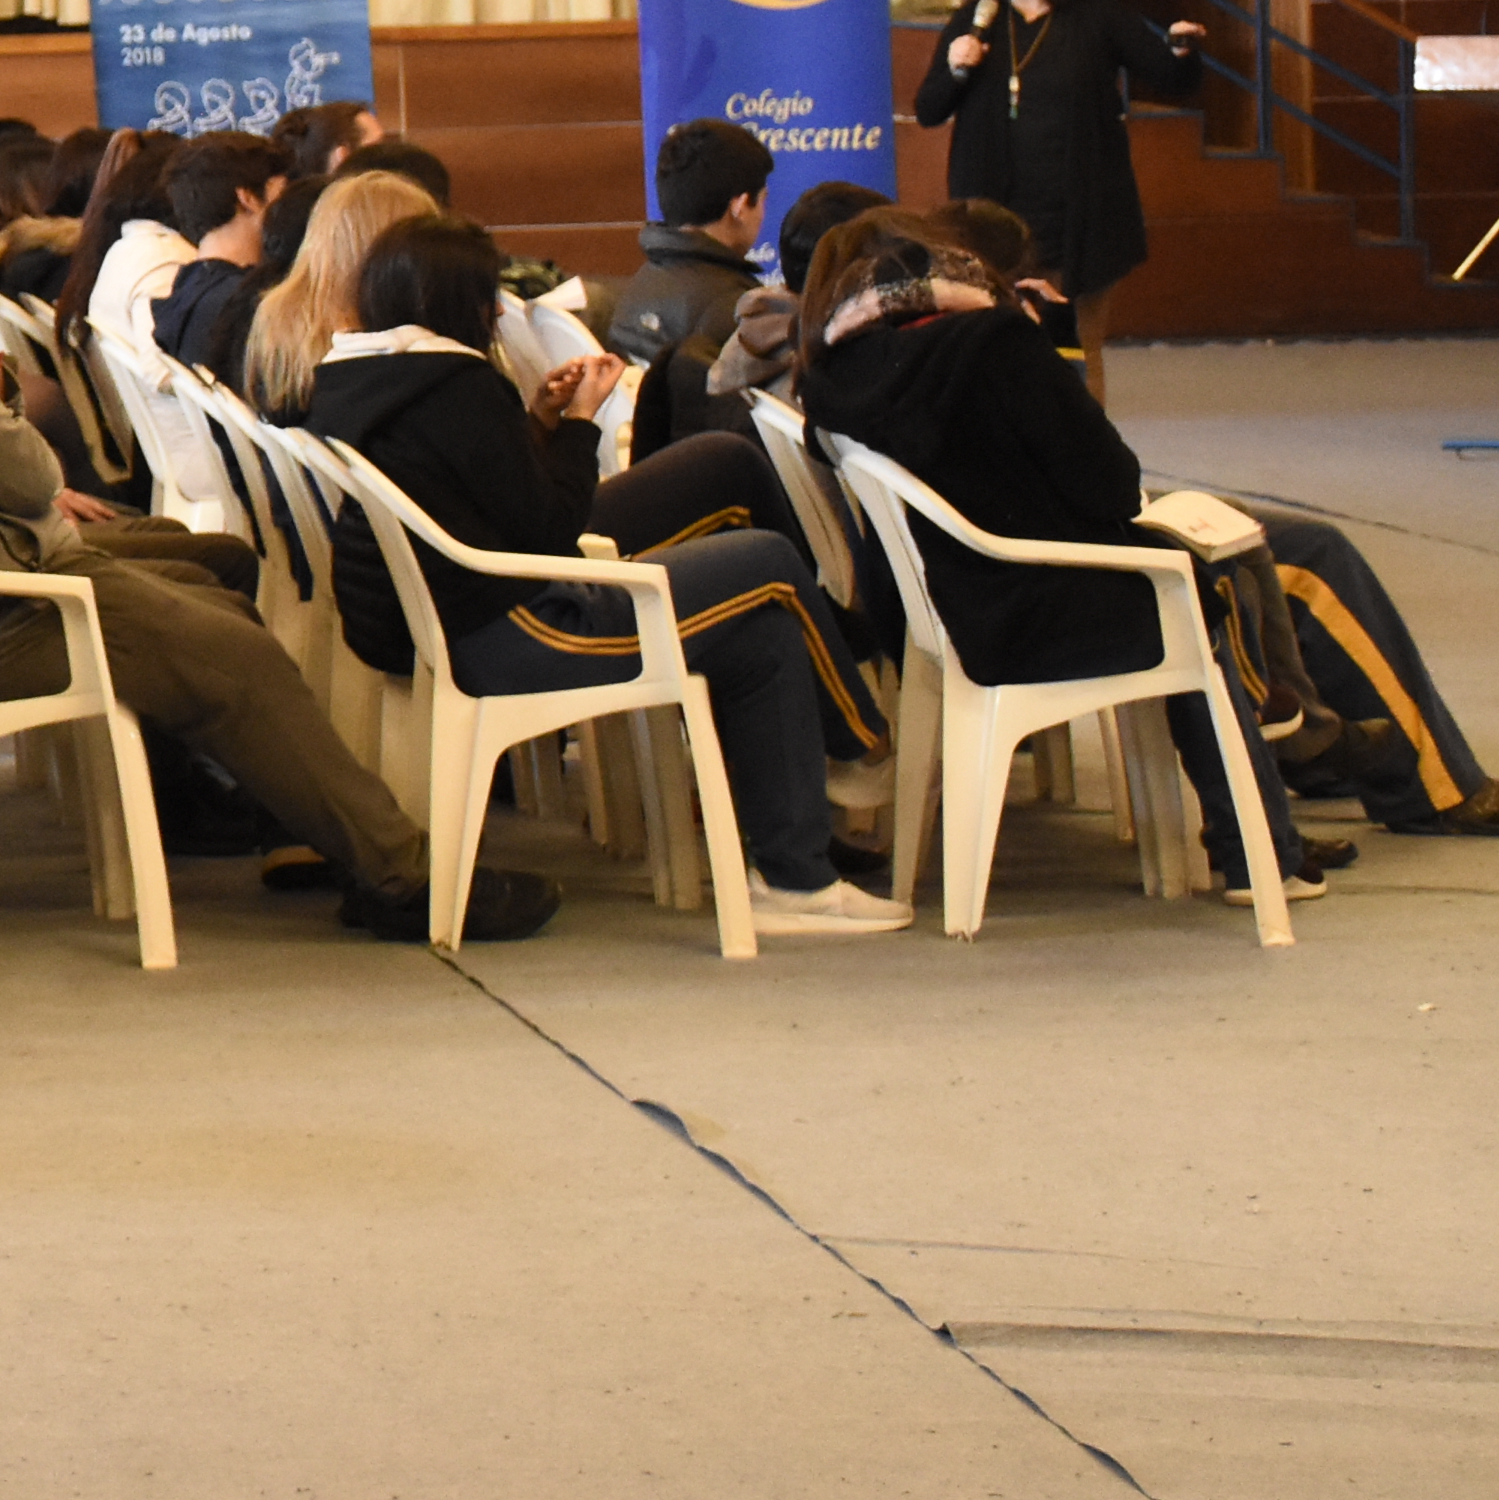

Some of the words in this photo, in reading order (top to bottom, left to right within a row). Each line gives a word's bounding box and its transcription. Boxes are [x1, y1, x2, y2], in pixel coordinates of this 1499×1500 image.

[119, 23, 146, 45] 23
[150, 21, 178, 43] de
[182, 22, 252, 47] Agosto
[121, 46, 166, 67] 2018
[724, 88, 815, 125] Colegio
